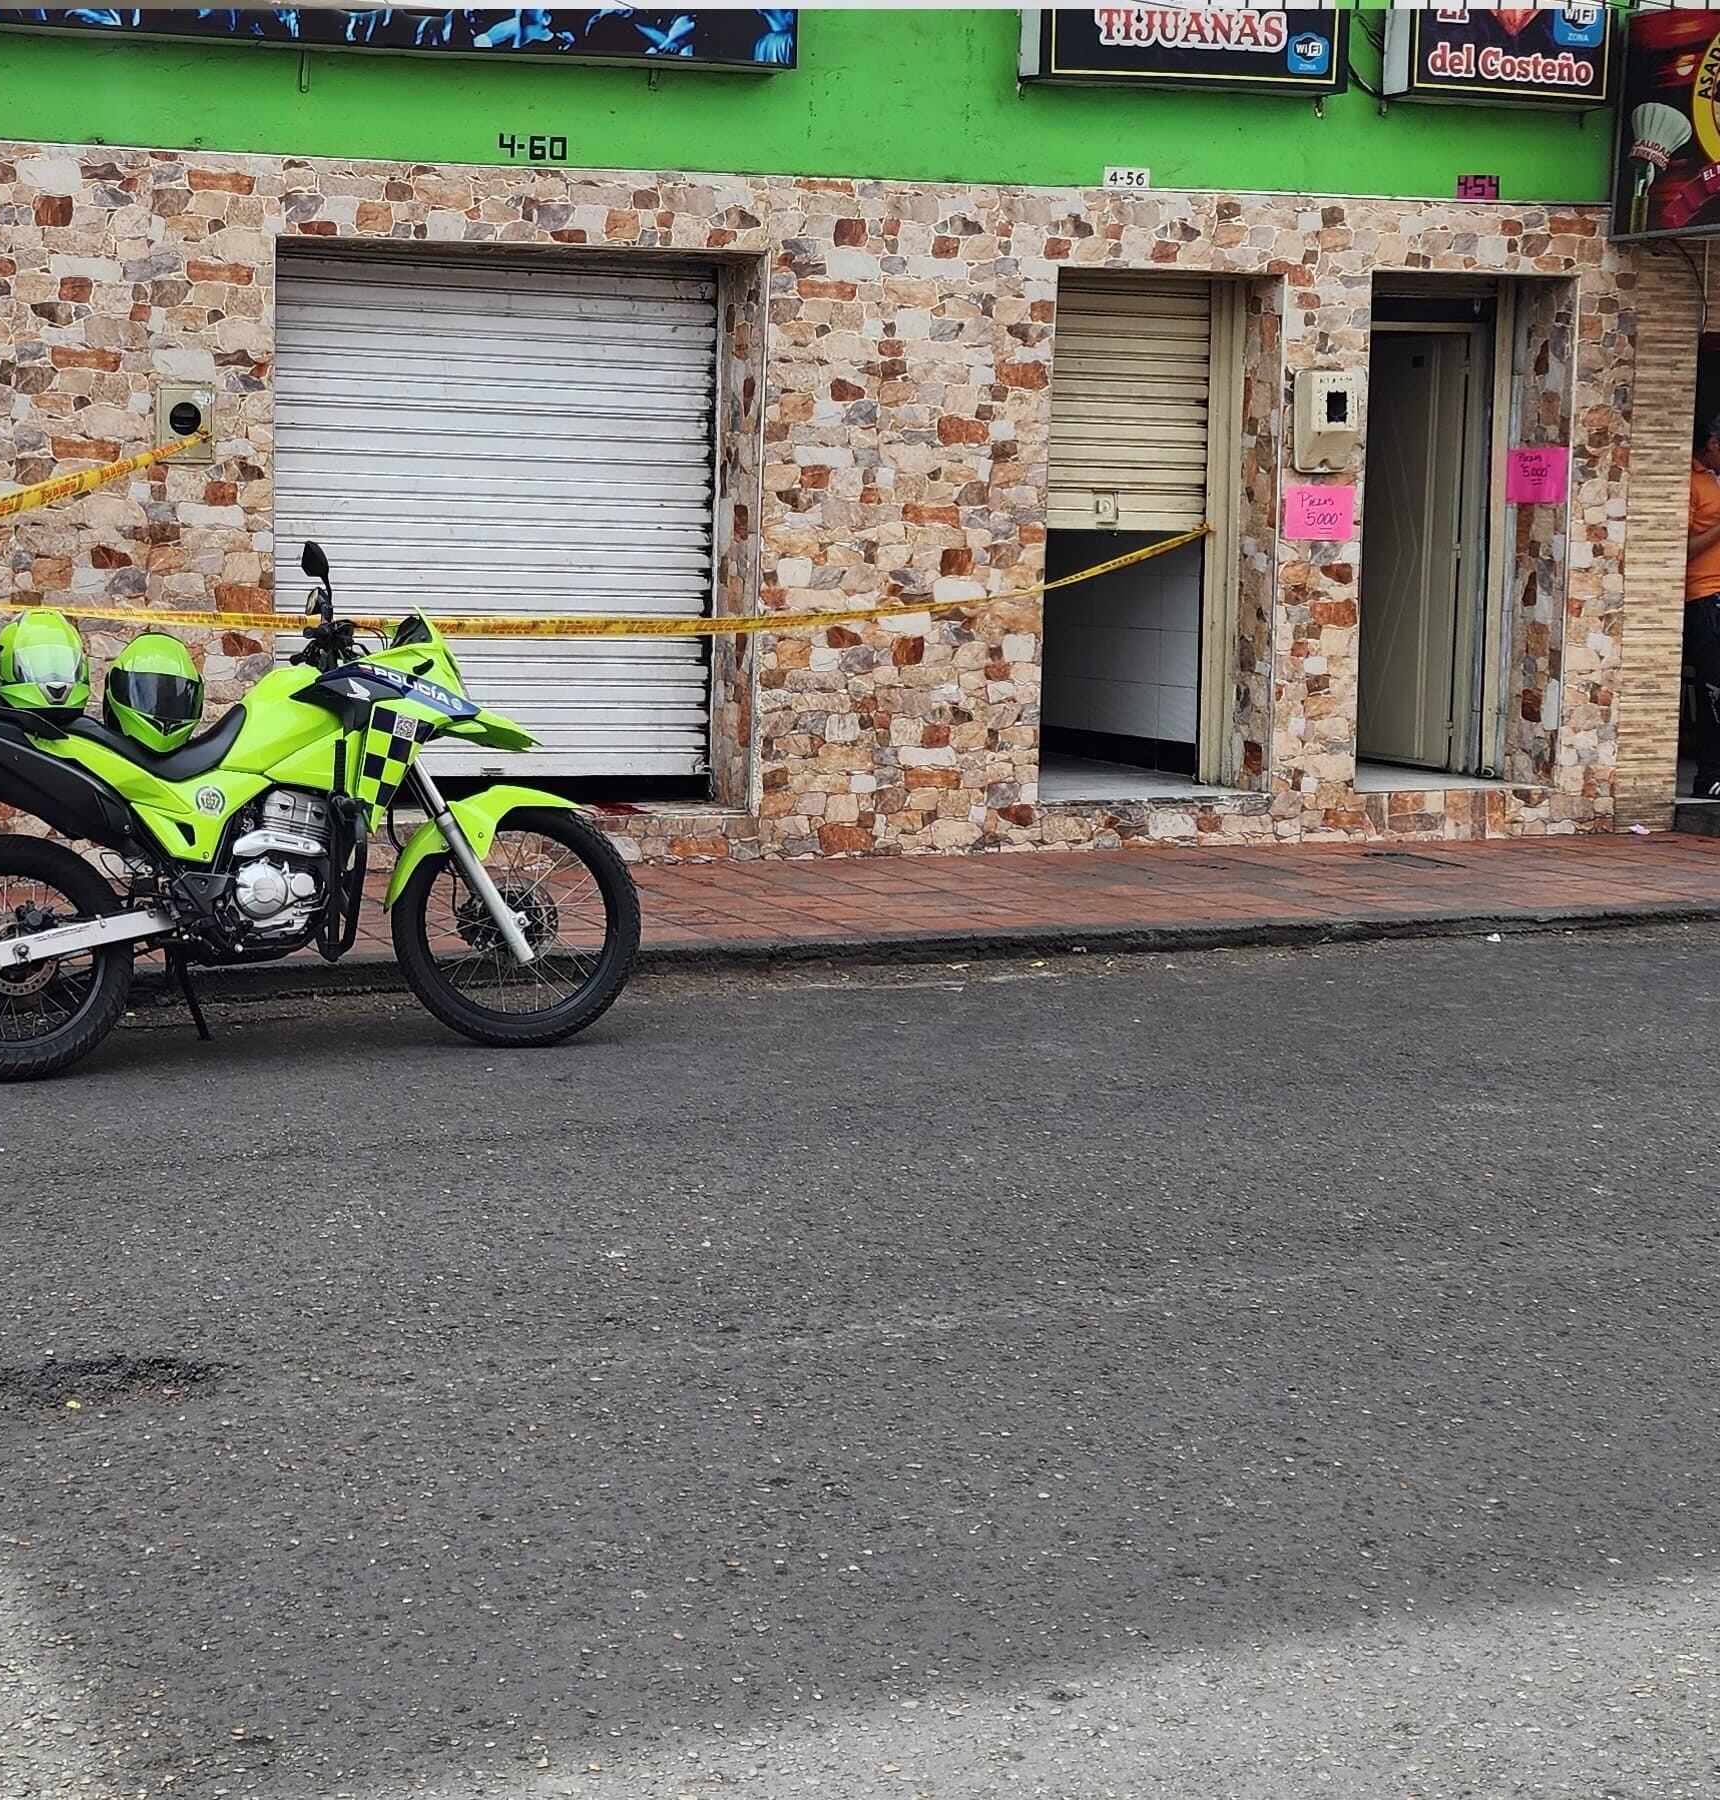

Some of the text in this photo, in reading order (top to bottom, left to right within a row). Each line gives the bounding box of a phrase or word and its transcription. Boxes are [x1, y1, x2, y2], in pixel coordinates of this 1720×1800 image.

[1097, 9, 1285, 50] TIJUANAS
[1429, 43, 1593, 84] del Costeño
[499, 133, 567, 160] 4-60
[1633, 138, 1672, 158] CALIDAD
[1108, 171, 1145, 186] 4-56
[1704, 168, 1716, 180] EL
[373, 667, 450, 705] POLICÍA
